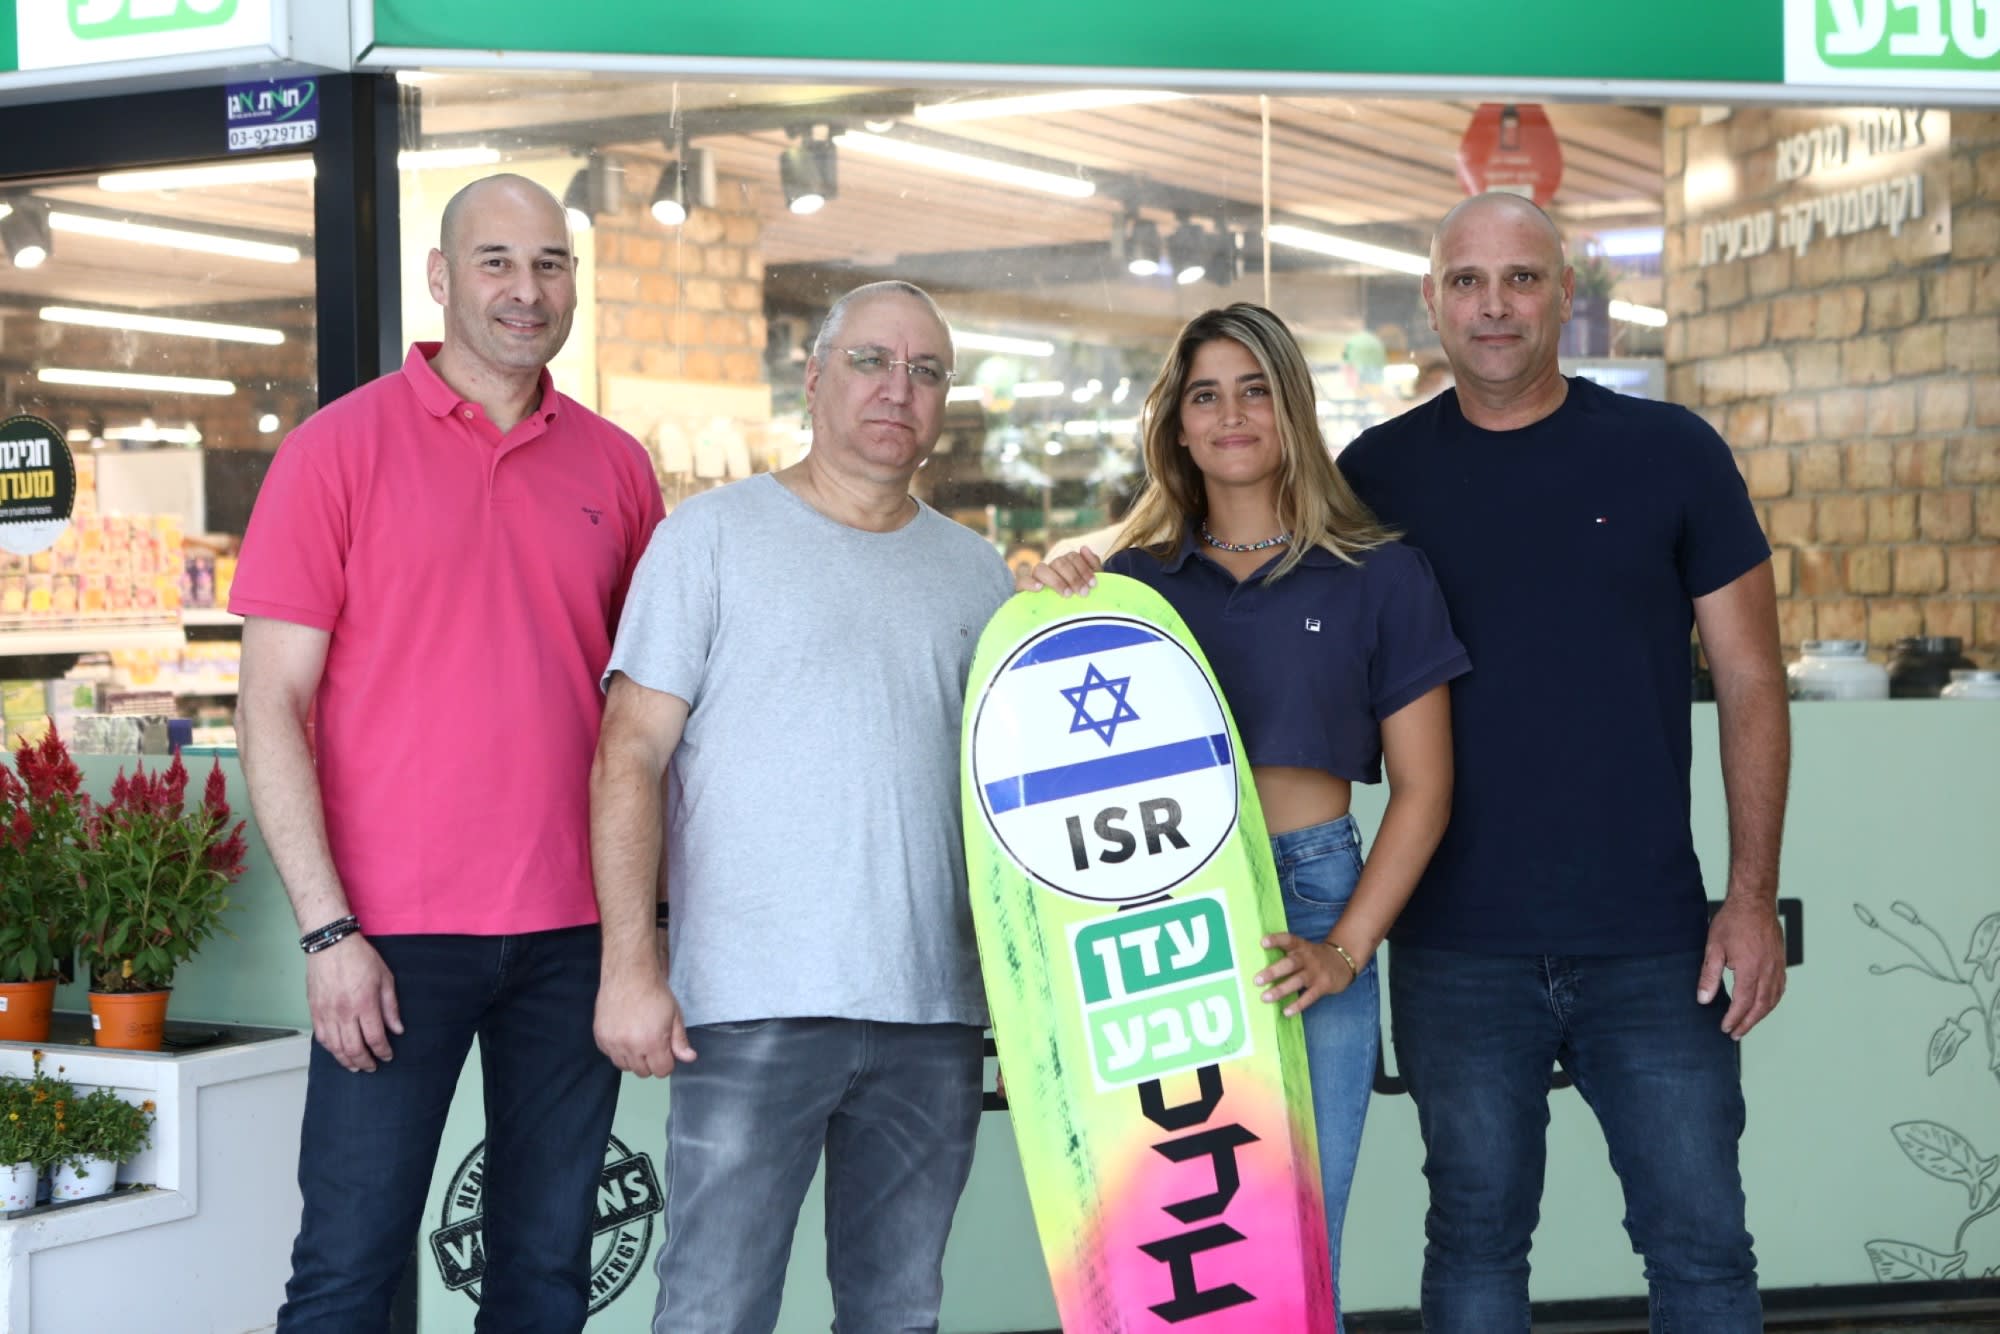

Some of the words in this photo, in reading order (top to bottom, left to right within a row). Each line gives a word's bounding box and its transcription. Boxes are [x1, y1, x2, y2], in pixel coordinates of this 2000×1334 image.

[230, 124, 315, 146] 03-9229713
[1776, 123, 1849, 182] מרפא
[1700, 210, 1775, 266] טבעית
[1780, 174, 1923, 257] וקוסמטיקה
[1065, 797, 1191, 872] ISR
[1092, 914, 1210, 999] עדן
[1102, 994, 1233, 1072] טבע
